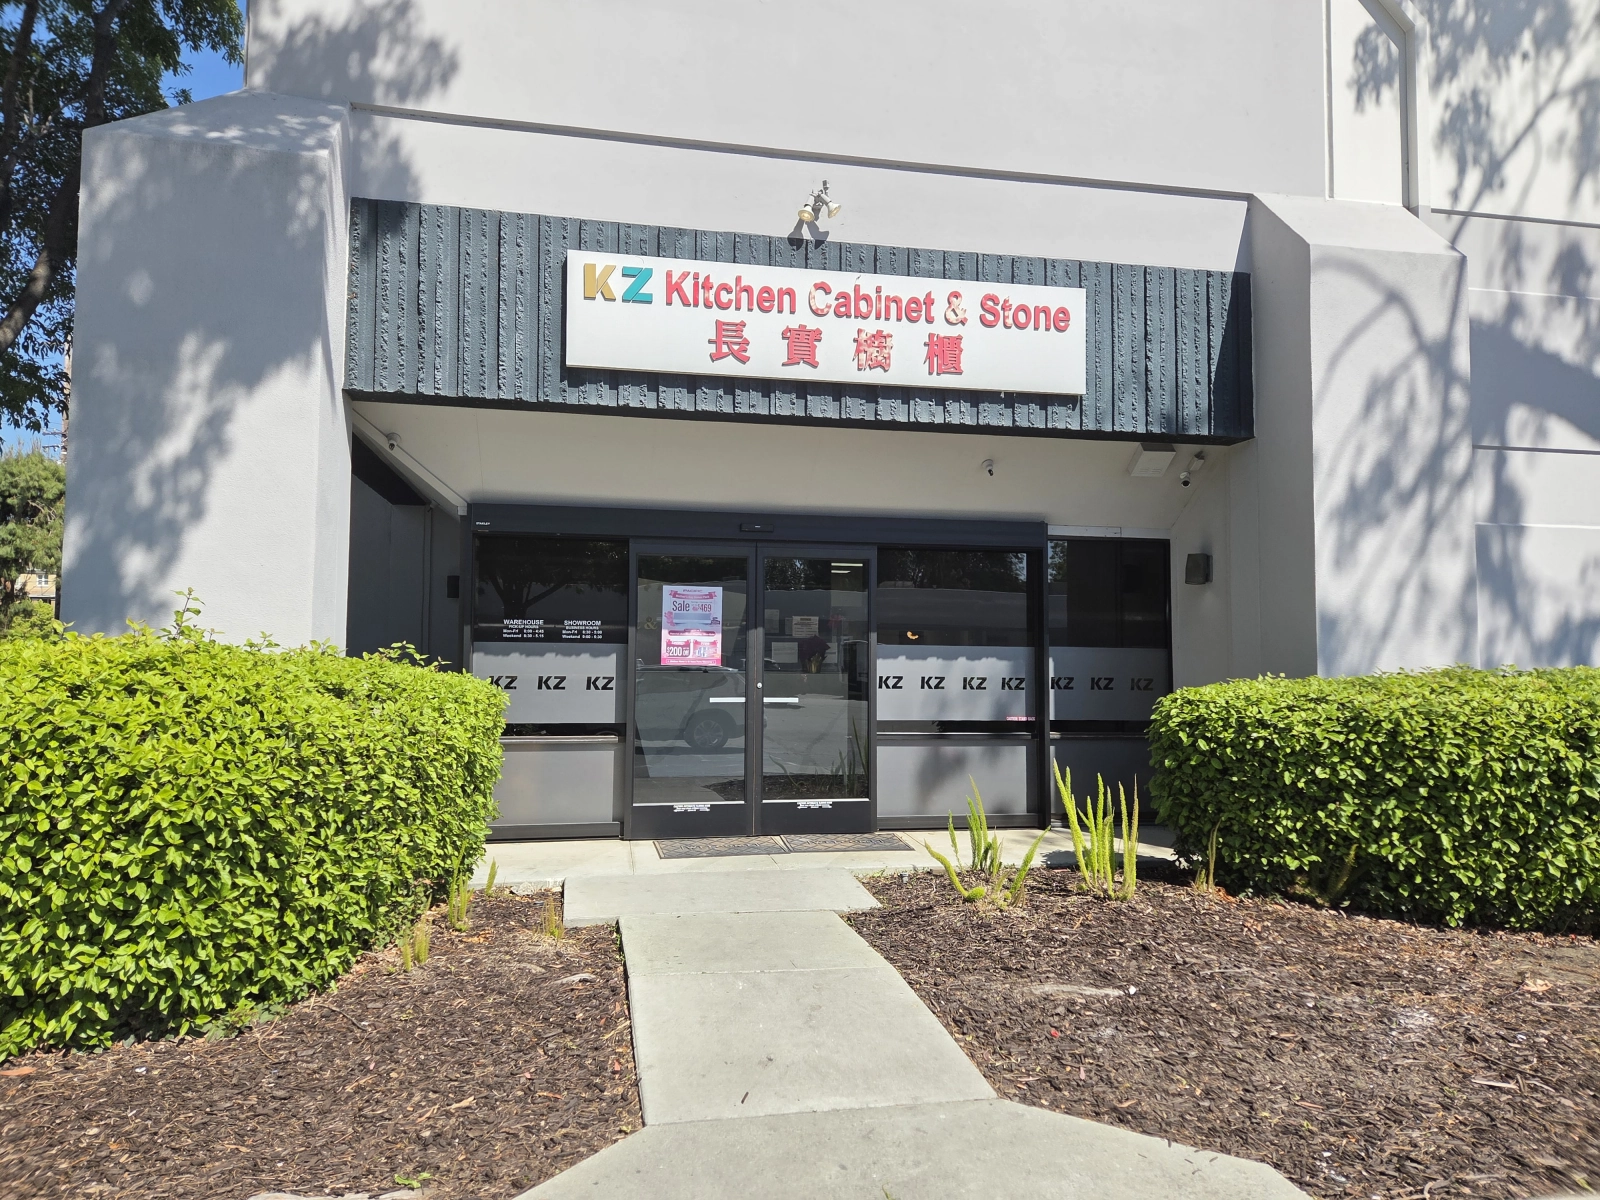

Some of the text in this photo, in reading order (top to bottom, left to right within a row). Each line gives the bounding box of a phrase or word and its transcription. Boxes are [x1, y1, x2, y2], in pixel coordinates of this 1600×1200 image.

[583, 263, 1071, 332] KZ Kitchen Cabinet & Stone
[672, 600, 690, 612] Sale
[667, 646, 682, 656] $200
[489, 676, 615, 690] KZ KZ KZ
[878, 676, 1026, 690] KZ KZ KZ KZ
[1050, 677, 1154, 691] KZ KZ KZ
